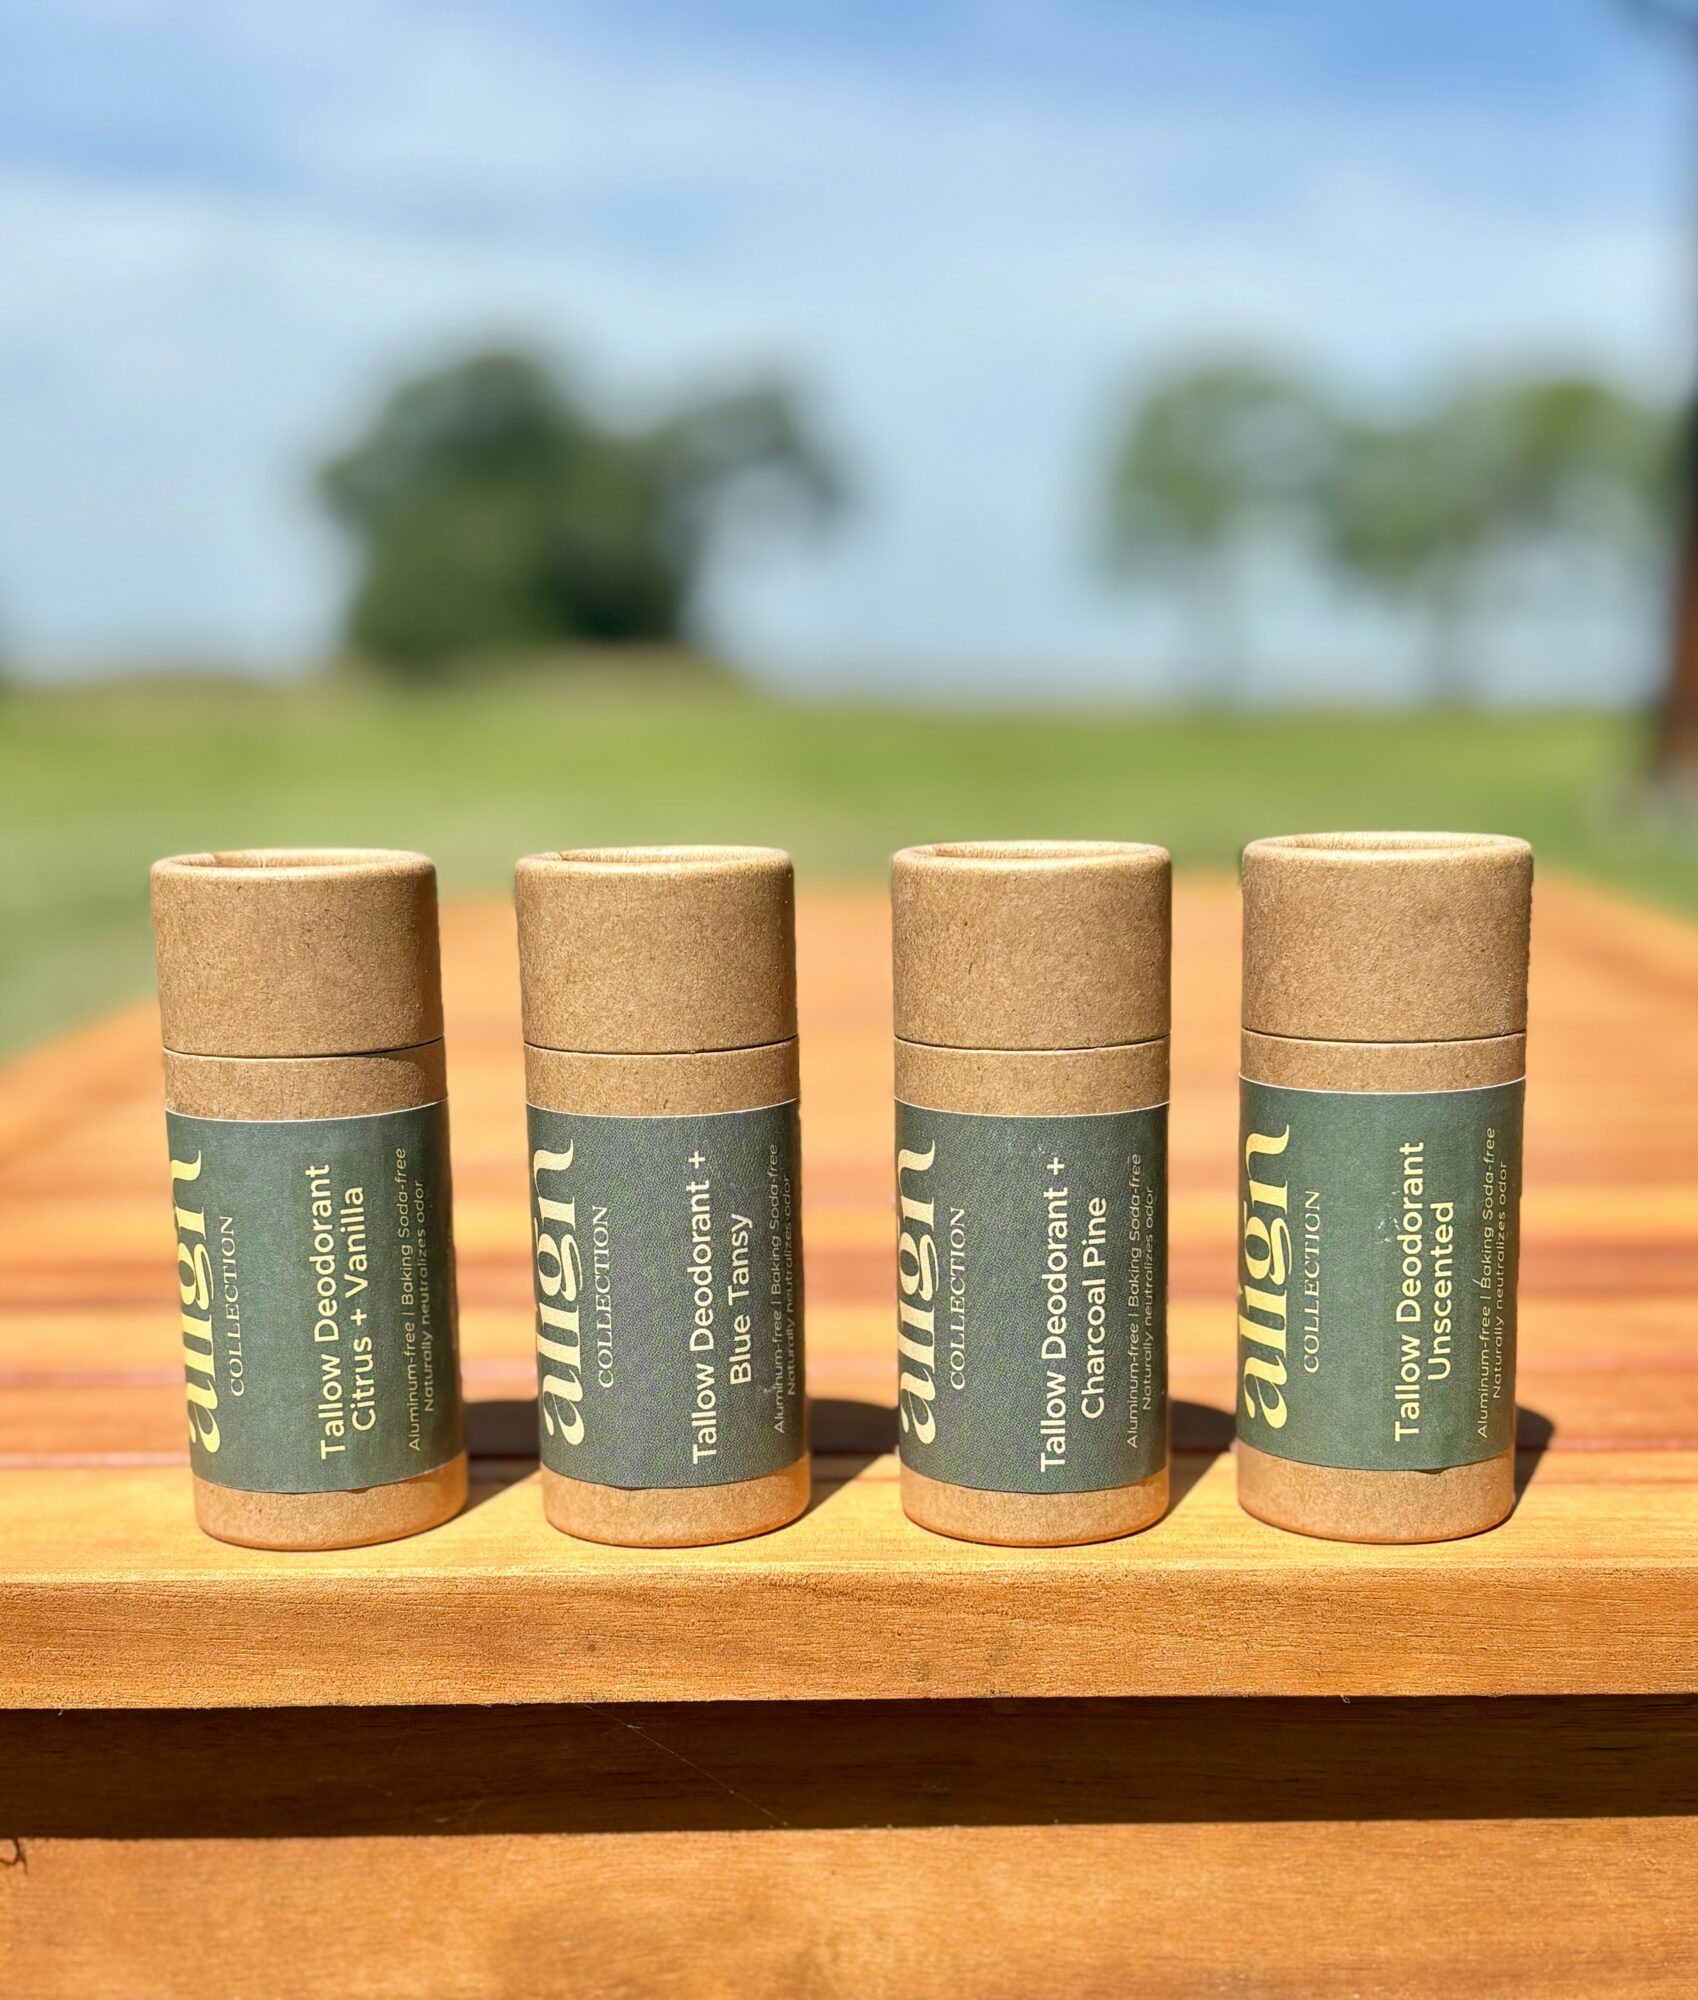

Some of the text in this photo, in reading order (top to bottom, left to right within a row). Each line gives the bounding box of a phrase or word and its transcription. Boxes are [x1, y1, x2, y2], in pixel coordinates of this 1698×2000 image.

[397, 1147, 411, 1237] Soda-free
[768, 1144, 780, 1229] Soda-free
[1128, 1154, 1142, 1236] Soda-free
[1480, 1225, 1494, 1289] Baking
[1481, 1127, 1495, 1218] Soda-free
[220, 1216, 244, 1397] COLLECTION
[305, 1164, 345, 1461] Tallow Deodorant
[340, 1186, 376, 1431] Citrus + Vanilla
[401, 1244, 414, 1306] Baking
[413, 1180, 434, 1411] Naturally neutralizes odor
[534, 1138, 585, 1445] align
[593, 1206, 614, 1388] COLLECTION
[686, 1151, 717, 1465] Tallow Deodorant +
[728, 1213, 753, 1384] Blue Tansy
[771, 1237, 782, 1297] Baking
[782, 1175, 795, 1396] Naturally neutralizes odor
[898, 1140, 940, 1445] align
[951, 1206, 965, 1390] COLLECTION
[1041, 1157, 1068, 1472] Tallow Deodorant +
[1081, 1197, 1107, 1420] Charcoal Pine
[1128, 1243, 1141, 1307] Baking
[1143, 1185, 1154, 1410] Naturally neutralizes odor
[1238, 1124, 1291, 1429] align
[1303, 1191, 1321, 1374] COLLECTION
[1395, 1142, 1424, 1442] Tallow Deodorant
[1427, 1201, 1454, 1381] Unscented
[1493, 1162, 1508, 1398] Naturally neutralizes odor
[405, 1322, 420, 1451] Aluminum-free
[771, 1312, 785, 1434] Aluminum-free
[1127, 1322, 1141, 1448] Aluminum-free
[1477, 1306, 1491, 1438] Aluminum-free
